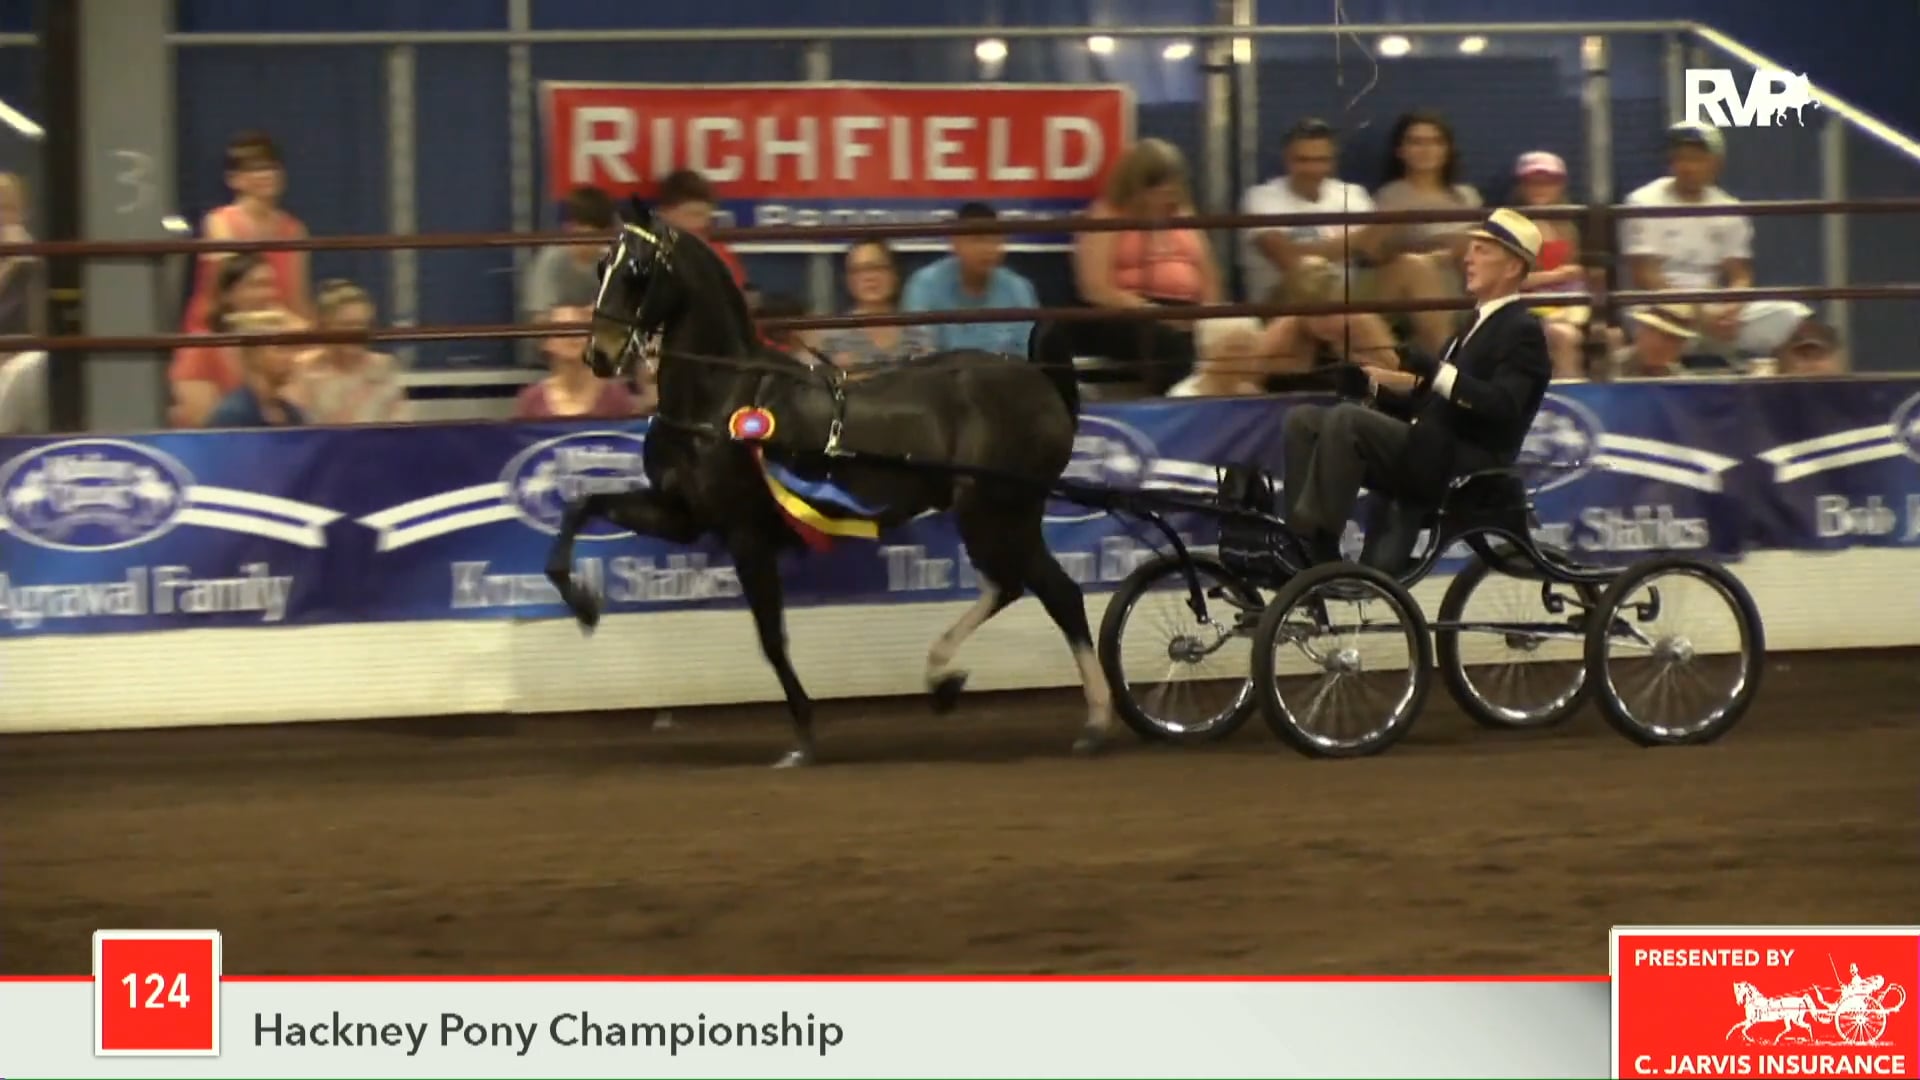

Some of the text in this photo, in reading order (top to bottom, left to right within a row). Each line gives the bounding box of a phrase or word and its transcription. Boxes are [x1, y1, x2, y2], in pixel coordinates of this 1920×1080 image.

[571, 106, 1103, 182] RICHFIELD
[111, 150, 151, 213] 3
[152, 562, 294, 622] Family
